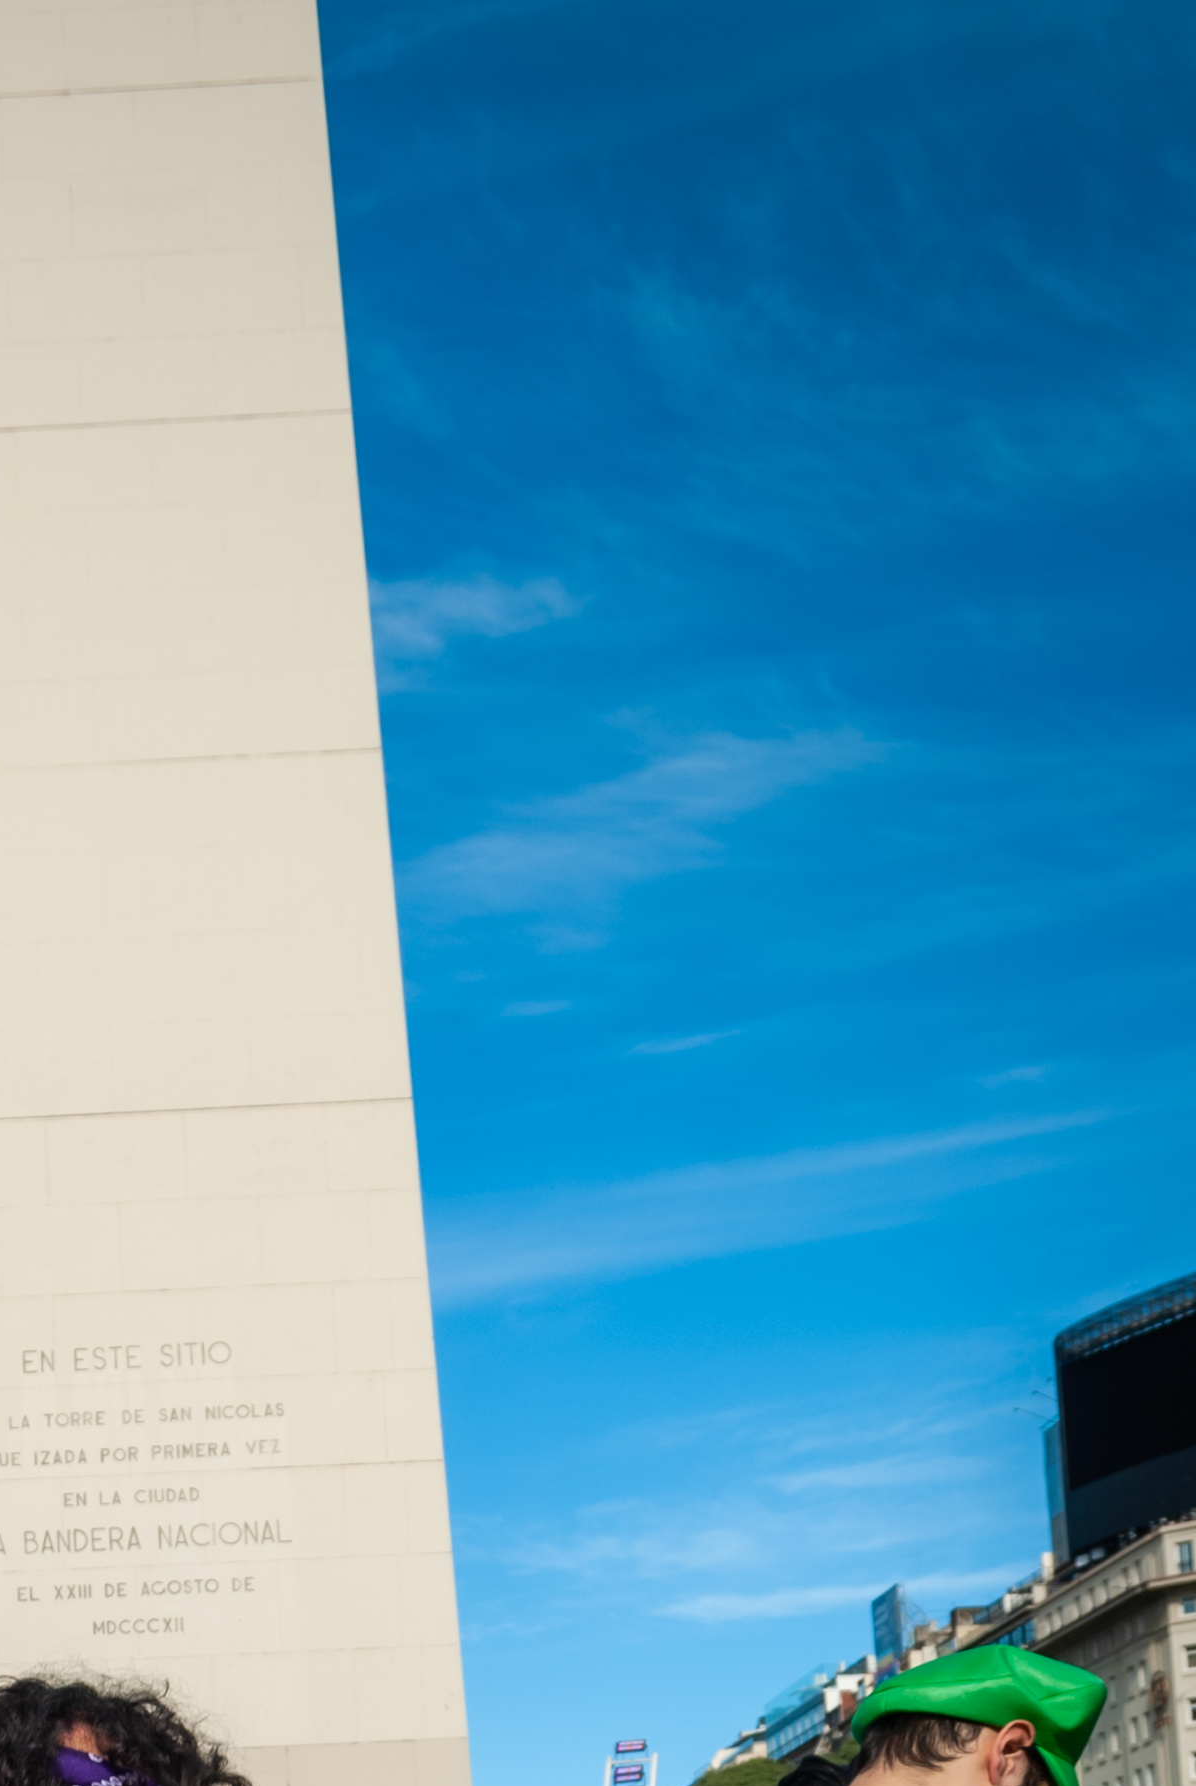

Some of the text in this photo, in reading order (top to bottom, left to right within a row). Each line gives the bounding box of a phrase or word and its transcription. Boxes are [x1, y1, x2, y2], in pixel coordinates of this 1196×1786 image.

[22, 1341, 232, 1373] EN ESTE SITIO
[8, 1415, 31, 1430] LA
[44, 1411, 106, 1428] TORRE
[122, 1409, 145, 1425] DE
[158, 1407, 192, 1422] SAN
[205, 1402, 286, 1420] NICOLAS
[33, 1449, 88, 1467] IZADA
[100, 1446, 139, 1463] POR
[151, 1442, 231, 1461] PRIMERA
[245, 1438, 282, 1455] VEZ
[63, 1487, 200, 1507] EN LA CIUDAD
[23, 1526, 142, 1555] BANDERA
[157, 1519, 293, 1549] NACIONAL
[17, 1577, 256, 1602] EL XXIII DE AGOSTO DE
[92, 1617, 185, 1635] MDCCCXII
